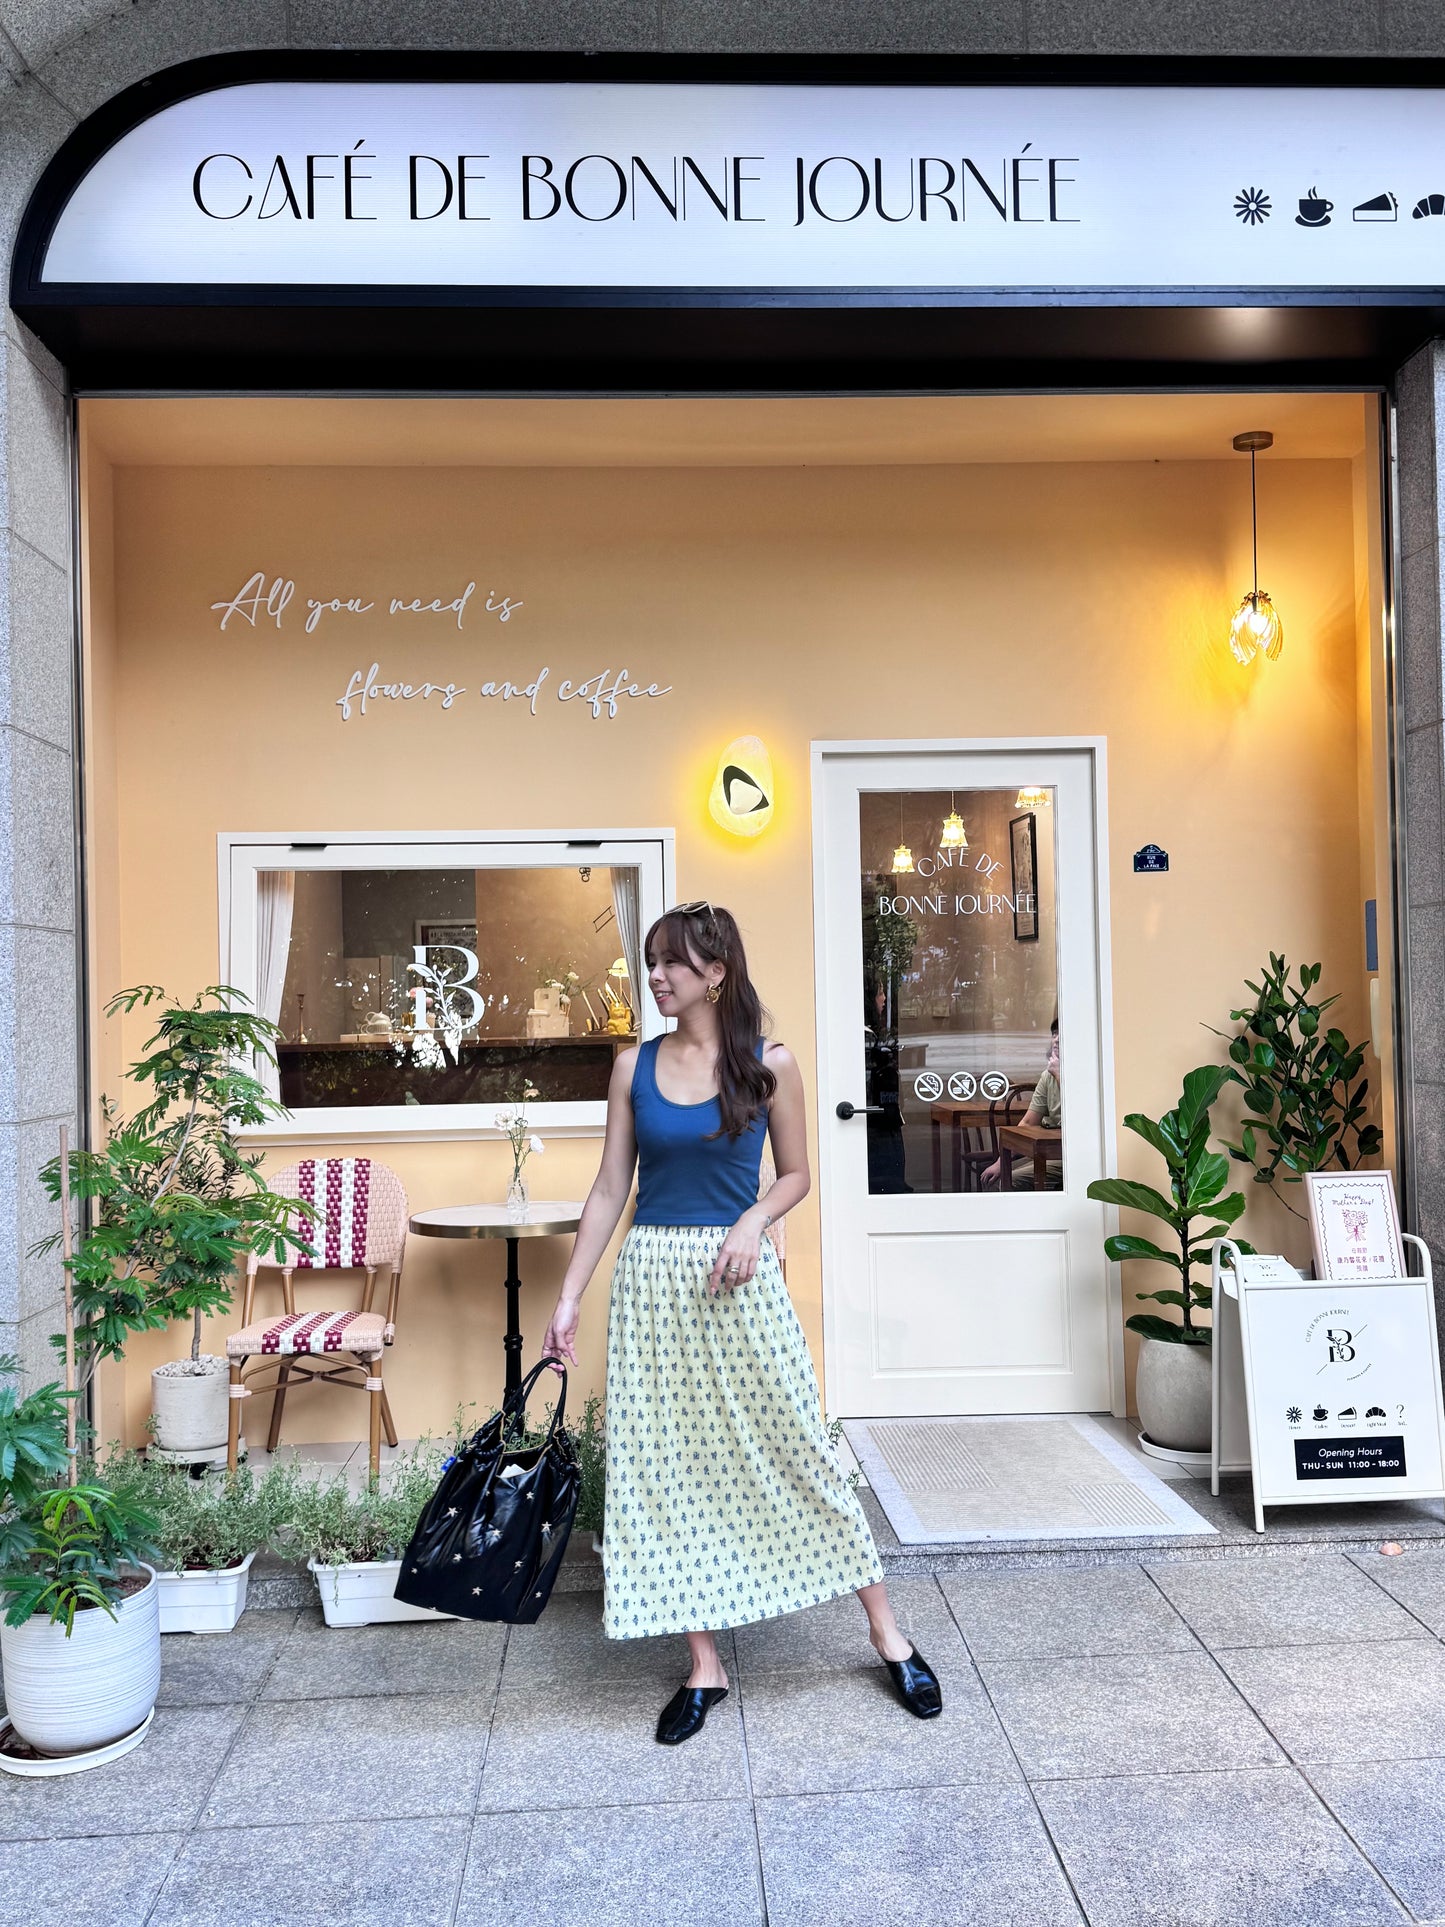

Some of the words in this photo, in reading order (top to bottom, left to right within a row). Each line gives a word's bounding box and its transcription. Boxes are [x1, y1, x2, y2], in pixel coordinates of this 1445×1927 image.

[192, 139, 378, 221] CAFÉ
[409, 154, 491, 221] DE
[521, 154, 766, 222] BONNE
[793, 142, 1081, 227] JOURNÉE
[210, 572, 295, 631] All
[305, 599, 375, 633] you
[389, 582, 476, 630] need
[485, 590, 524, 622] is
[336, 663, 467, 721] flowers
[481, 667, 549, 715] and
[558, 669, 673, 719] coffee
[975, 853, 1005, 881] DE
[879, 895, 948, 916] BONNE
[954, 890, 1037, 916] JOURNÉE
[1318, 1448, 1355, 1458] Opening
[1357, 1447, 1383, 1456] Hours
[1348, 1460, 1370, 1468] 11:00
[1378, 1459, 1400, 1467] 18:00
